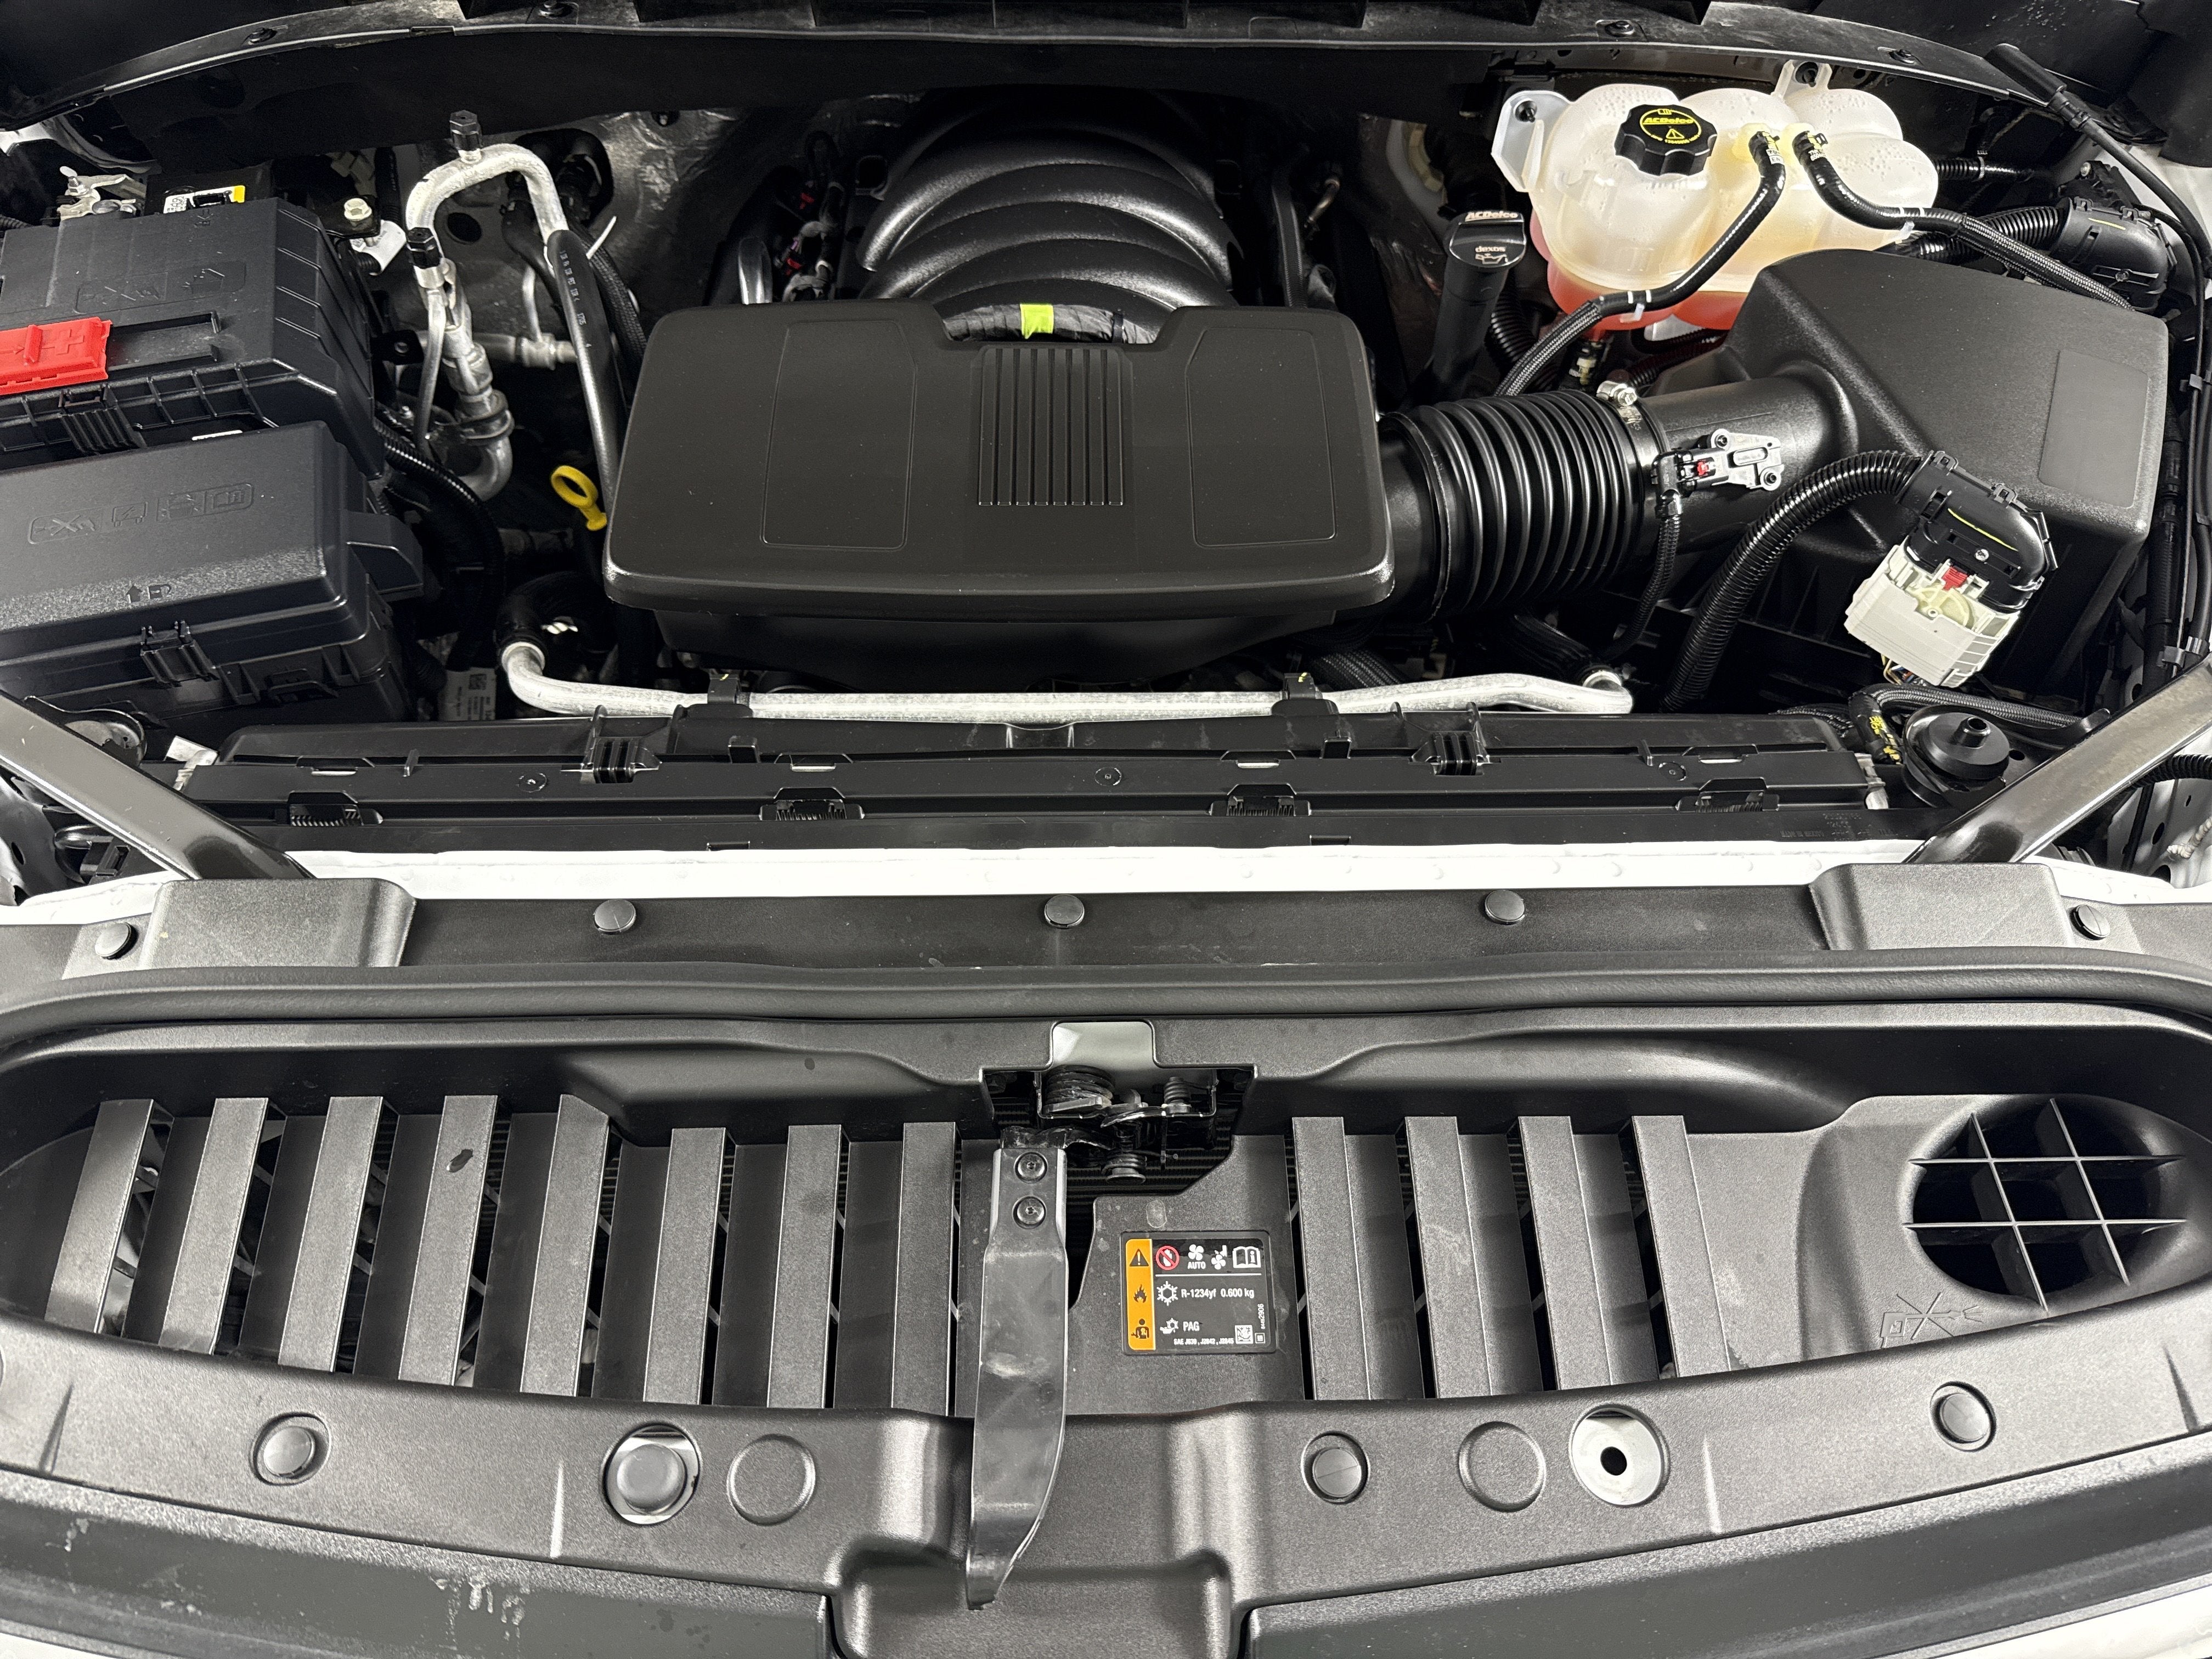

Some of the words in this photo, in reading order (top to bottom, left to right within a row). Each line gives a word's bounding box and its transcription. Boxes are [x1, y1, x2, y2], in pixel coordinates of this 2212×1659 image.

[1465, 211, 1519, 219] ACDelco
[1187, 1261, 1206, 1269] AUTO
[1181, 1288, 1217, 1299] R-1234yf
[1220, 1288, 1243, 1297] 0.600
[1244, 1288, 1255, 1299] kg
[1183, 1321, 1200, 1331] PAG
